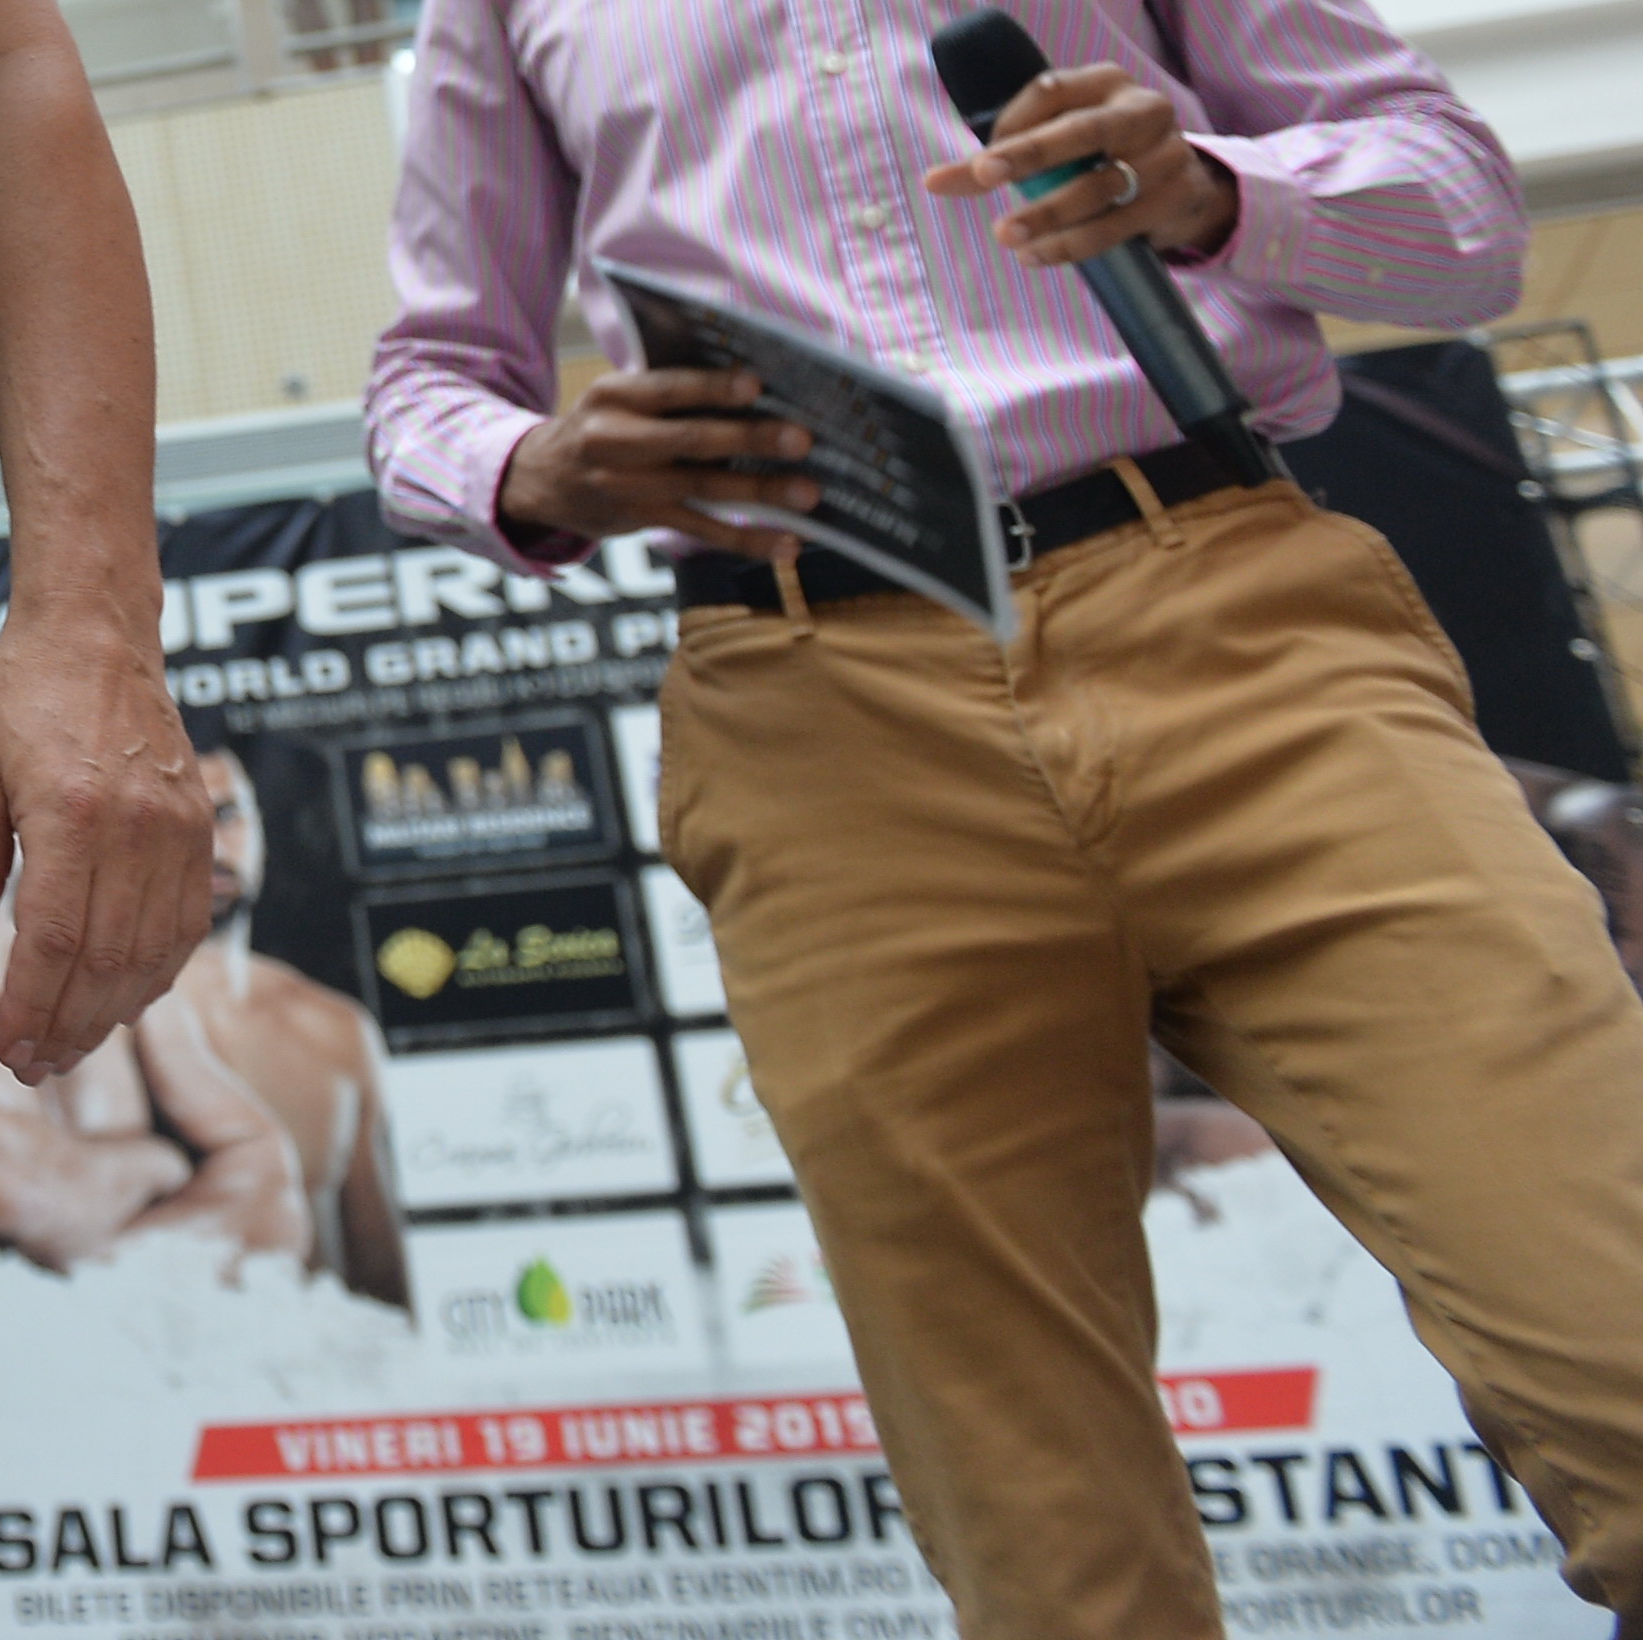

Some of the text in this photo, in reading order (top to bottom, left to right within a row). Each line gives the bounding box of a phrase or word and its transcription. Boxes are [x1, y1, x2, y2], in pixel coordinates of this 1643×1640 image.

[364, 618, 599, 688] GRAND
[275, 1398, 882, 1473] VINERI 19 IUNIE 2015
[245, 1472, 905, 1566] SPORTURILOR
[14, 1586, 133, 1625] BILETE
[143, 1577, 370, 1622] DISPONIBILE
[381, 1573, 470, 1612] PRIN
